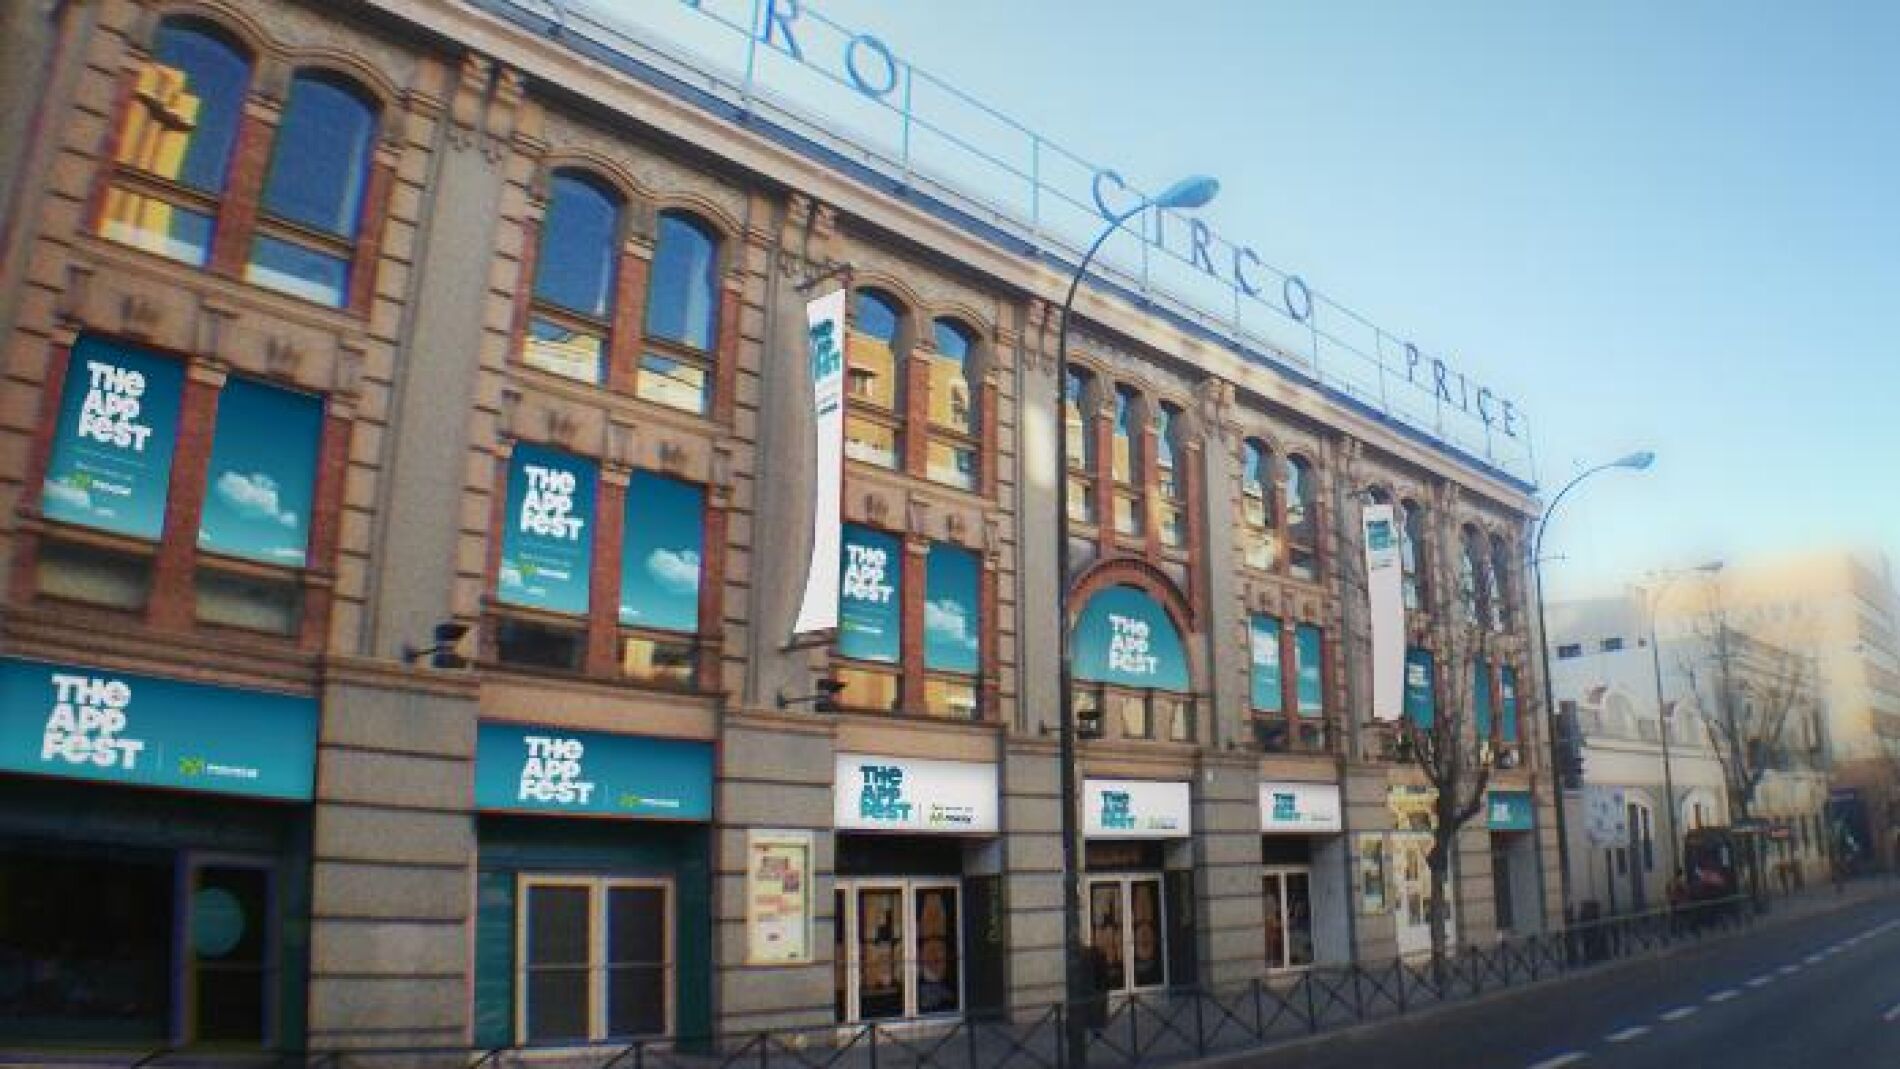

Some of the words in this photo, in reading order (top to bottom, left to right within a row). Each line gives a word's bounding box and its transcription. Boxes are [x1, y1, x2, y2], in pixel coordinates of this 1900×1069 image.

[682, 0, 896, 97] RO
[1092, 168, 1312, 322] CIRCO
[1404, 342, 1517, 438] PRICE
[80, 389, 140, 419] APP
[523, 490, 573, 515] APP
[46, 703, 127, 737] APP
[521, 757, 582, 782] APP
